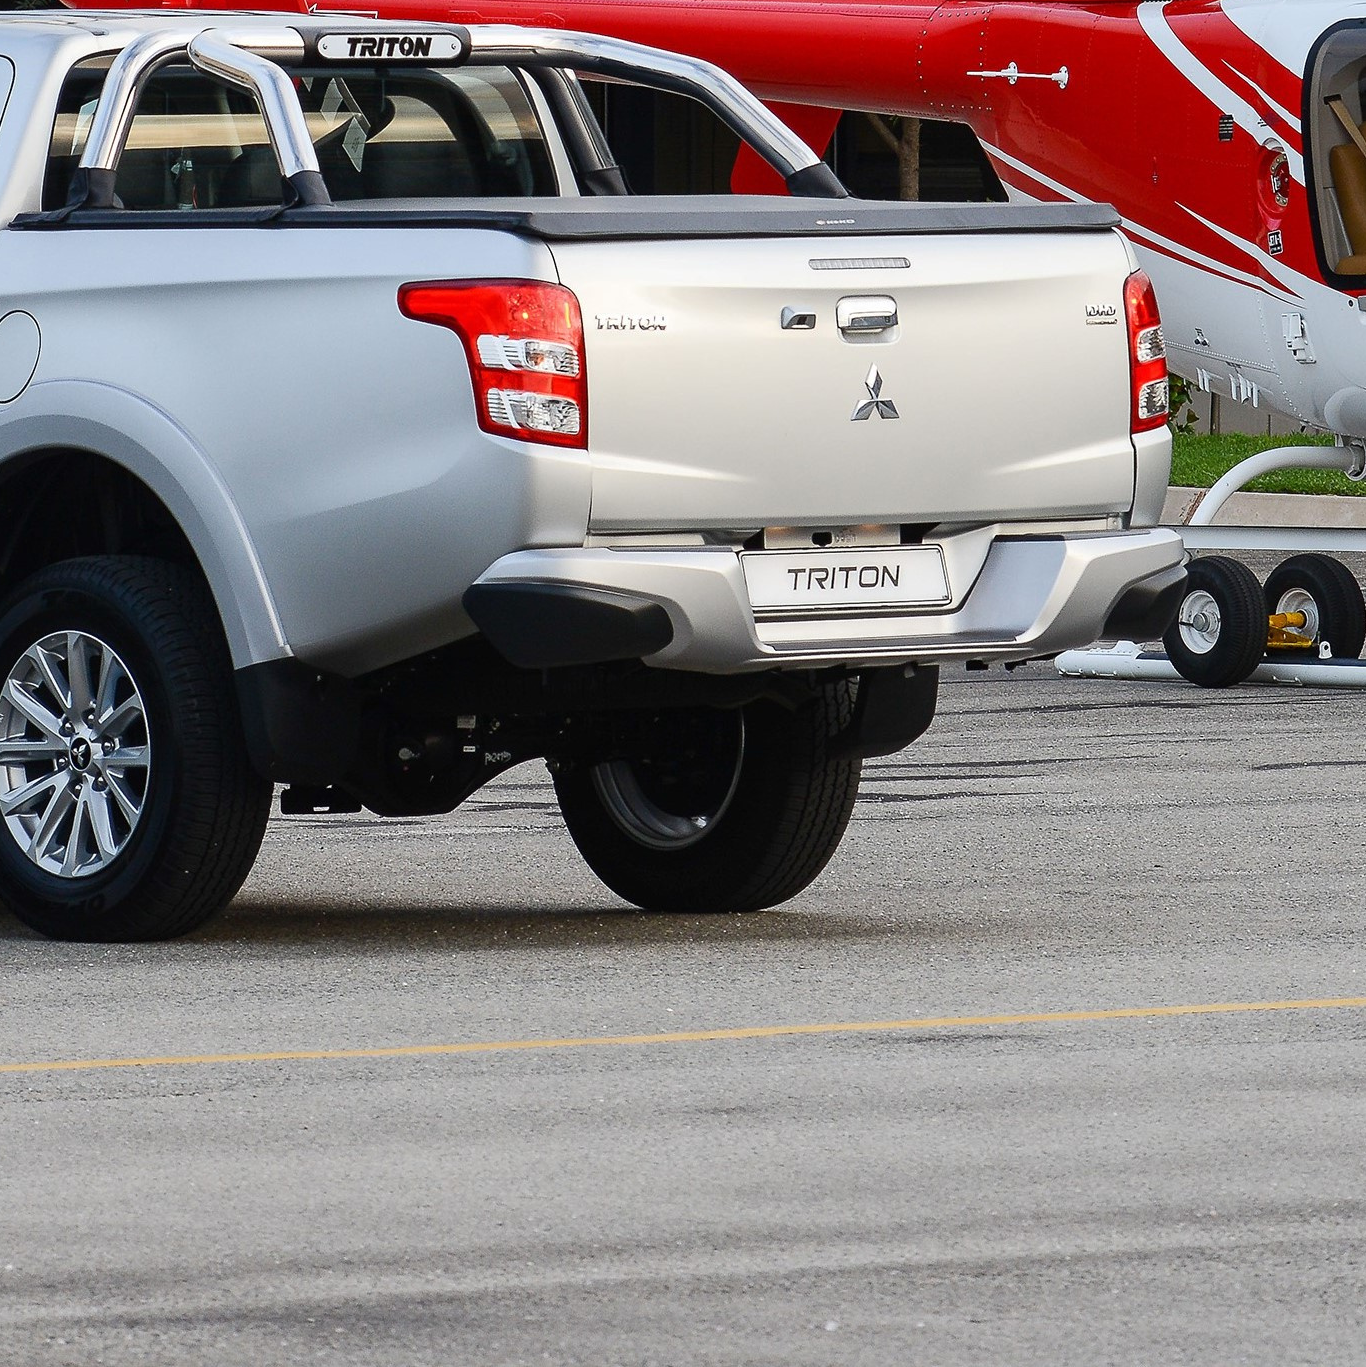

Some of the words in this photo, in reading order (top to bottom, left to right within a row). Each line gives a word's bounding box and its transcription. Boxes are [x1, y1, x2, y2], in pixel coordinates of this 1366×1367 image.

[347, 36, 433, 58] TRITON
[594, 314, 667, 331] TRITON
[787, 565, 901, 591] TRITON
